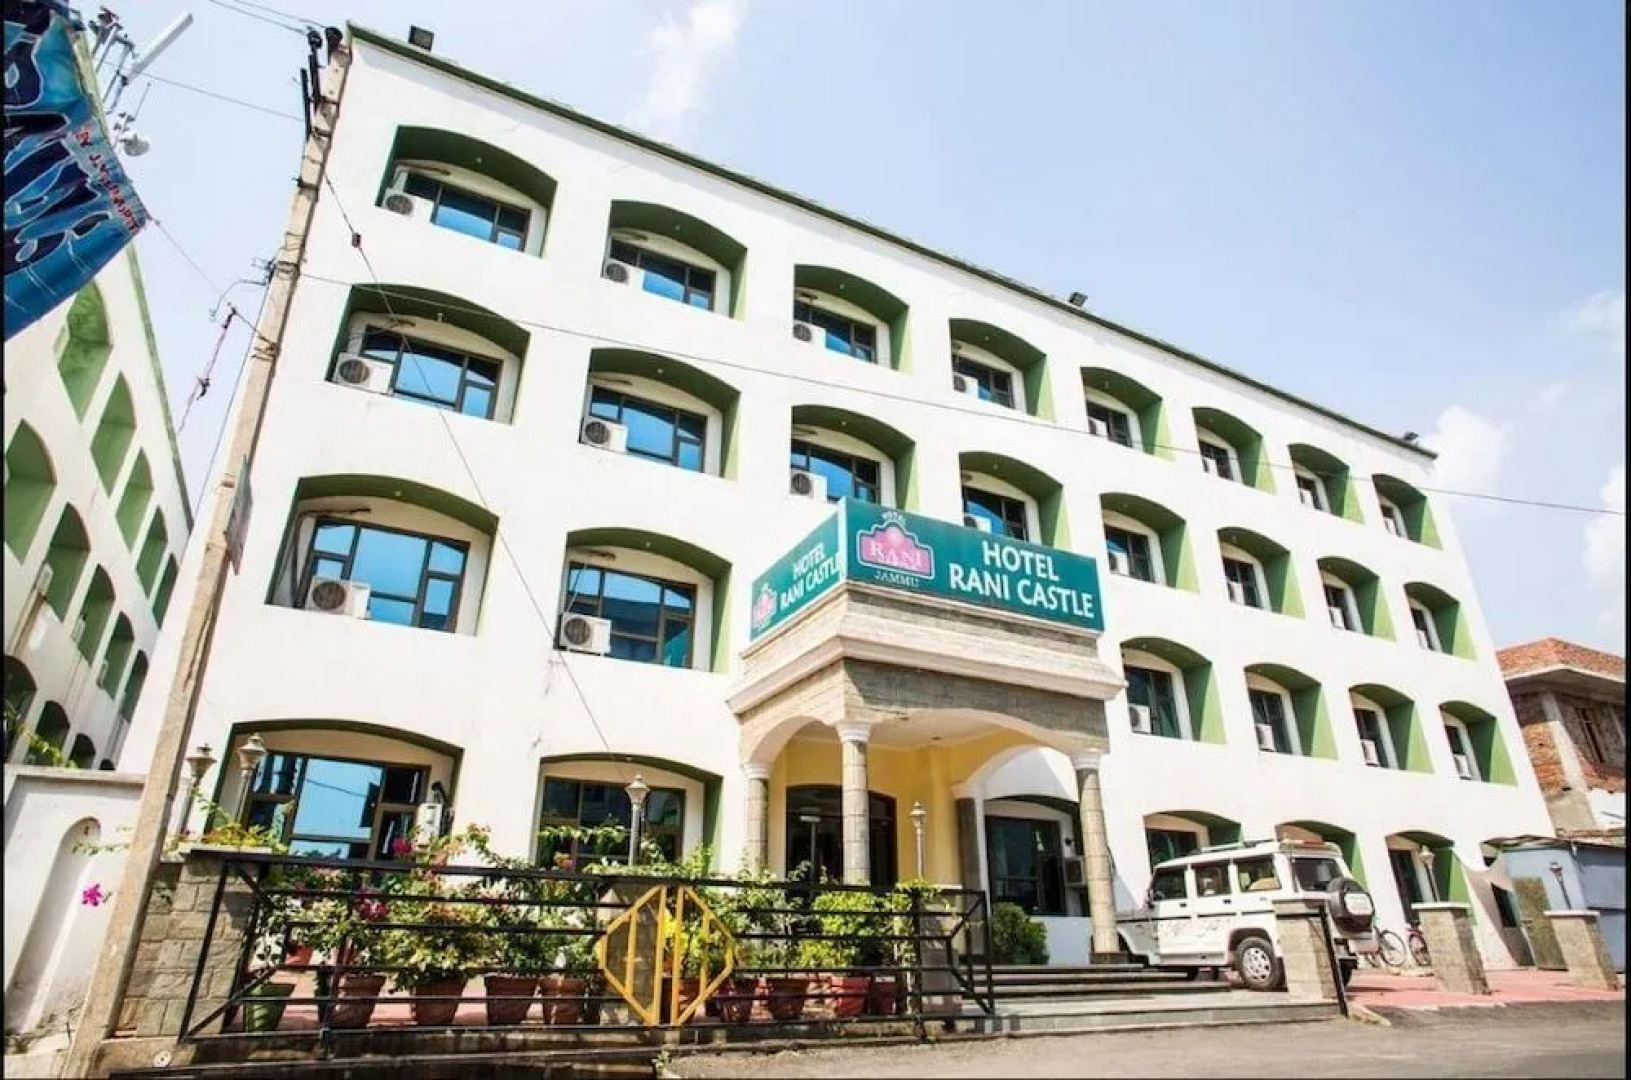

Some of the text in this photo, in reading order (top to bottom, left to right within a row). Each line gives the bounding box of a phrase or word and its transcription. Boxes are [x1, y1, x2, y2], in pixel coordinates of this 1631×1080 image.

[792, 542, 826, 580] HOTEL
[870, 540, 922, 570] RANI
[982, 540, 1060, 582] HOTEL
[780, 578, 804, 612] RANI
[874, 570, 919, 588] JAMMU
[949, 562, 1095, 619] RANI CASTLE
